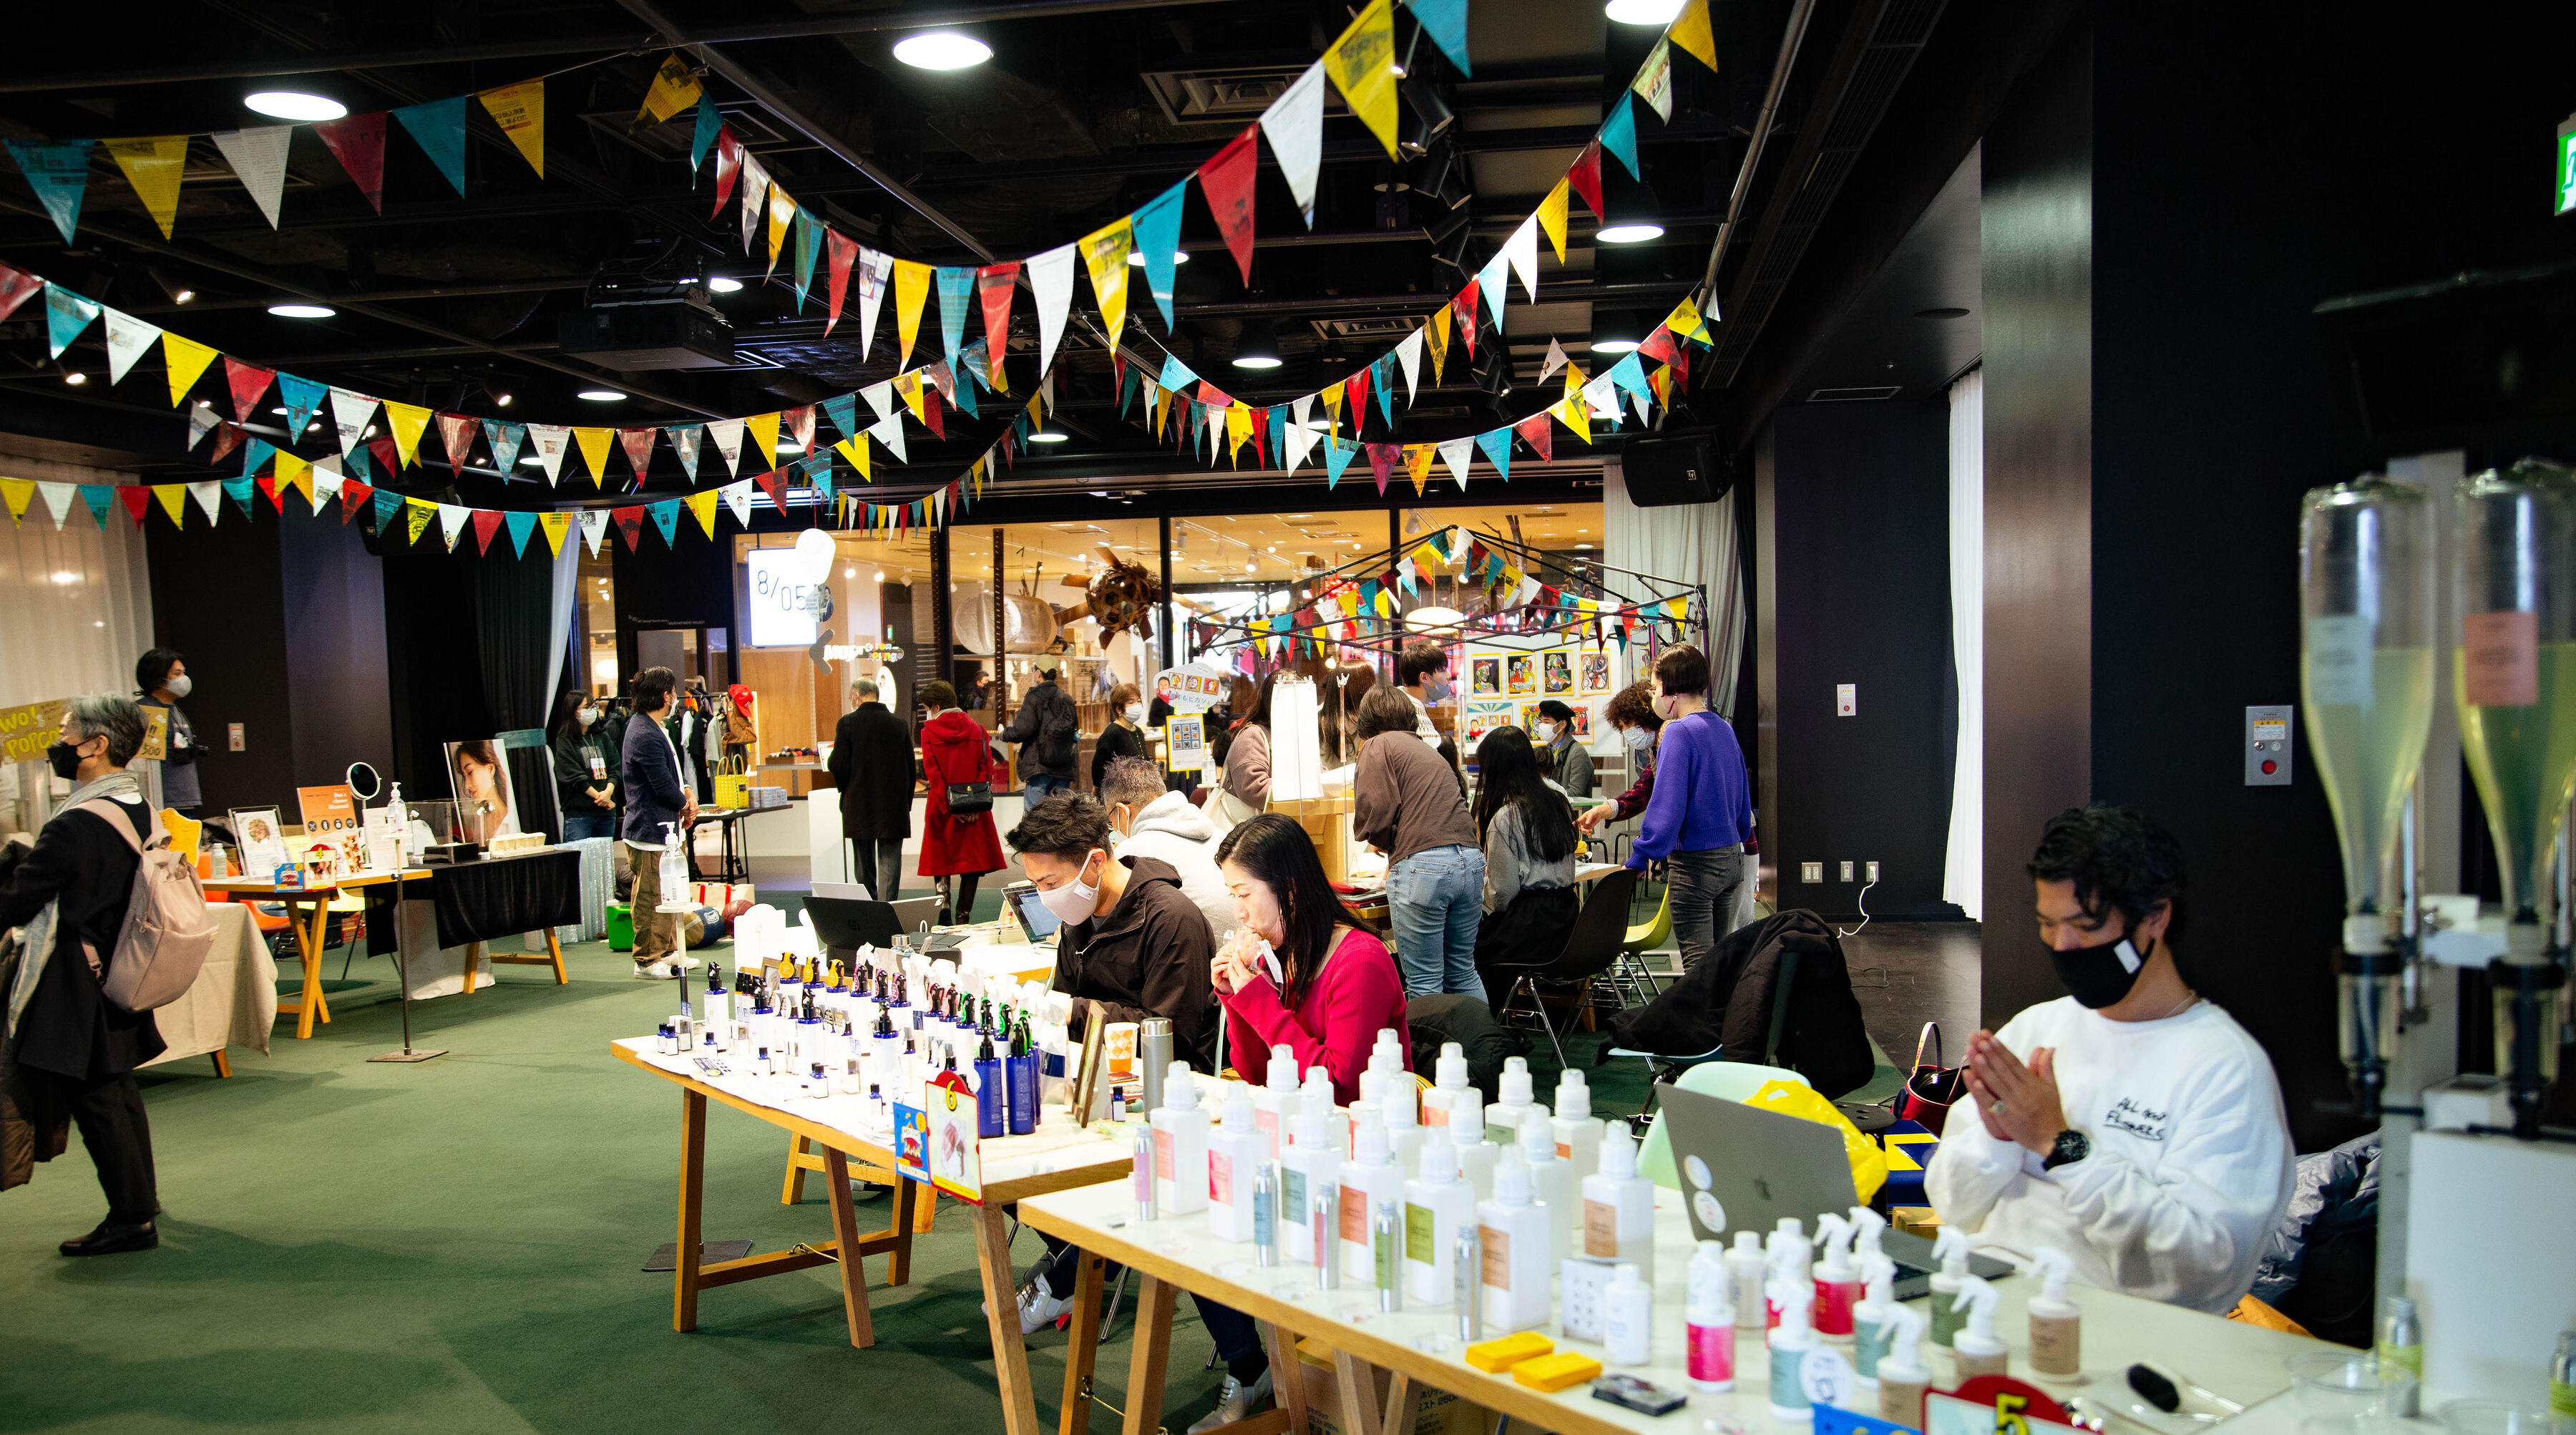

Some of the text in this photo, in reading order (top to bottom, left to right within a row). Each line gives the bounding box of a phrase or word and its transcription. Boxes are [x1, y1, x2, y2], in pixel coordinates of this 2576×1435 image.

[5, 726, 60, 759] POPCO
[316, 847, 324, 860] 4
[945, 1079, 957, 1111] 6
[1996, 1392, 2030, 1435] 5
